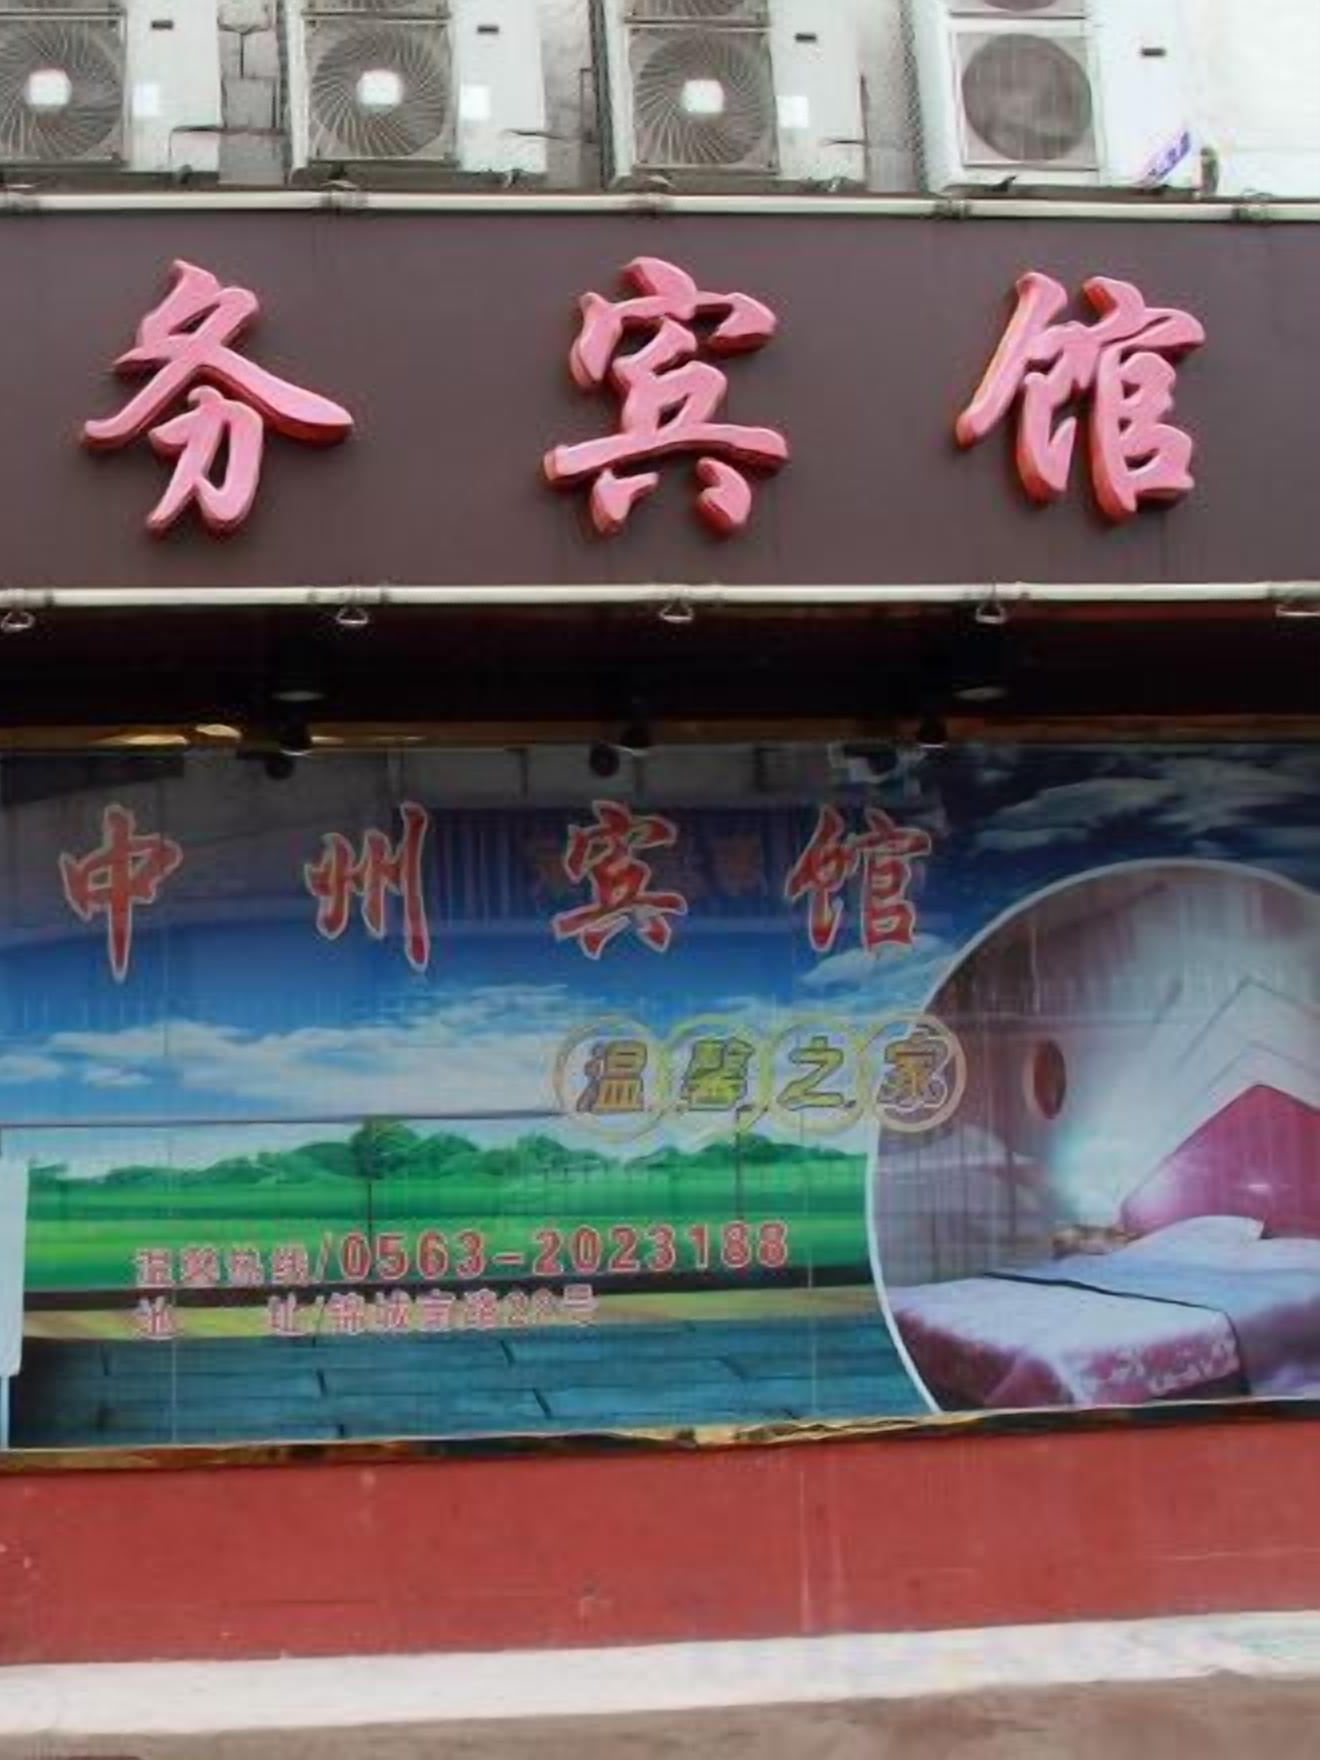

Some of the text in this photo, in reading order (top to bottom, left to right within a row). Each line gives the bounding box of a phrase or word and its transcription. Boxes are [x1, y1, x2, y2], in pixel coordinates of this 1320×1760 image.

[59, 800, 932, 983] 中州宾馆
[573, 1023, 950, 1113] 温馨之家
